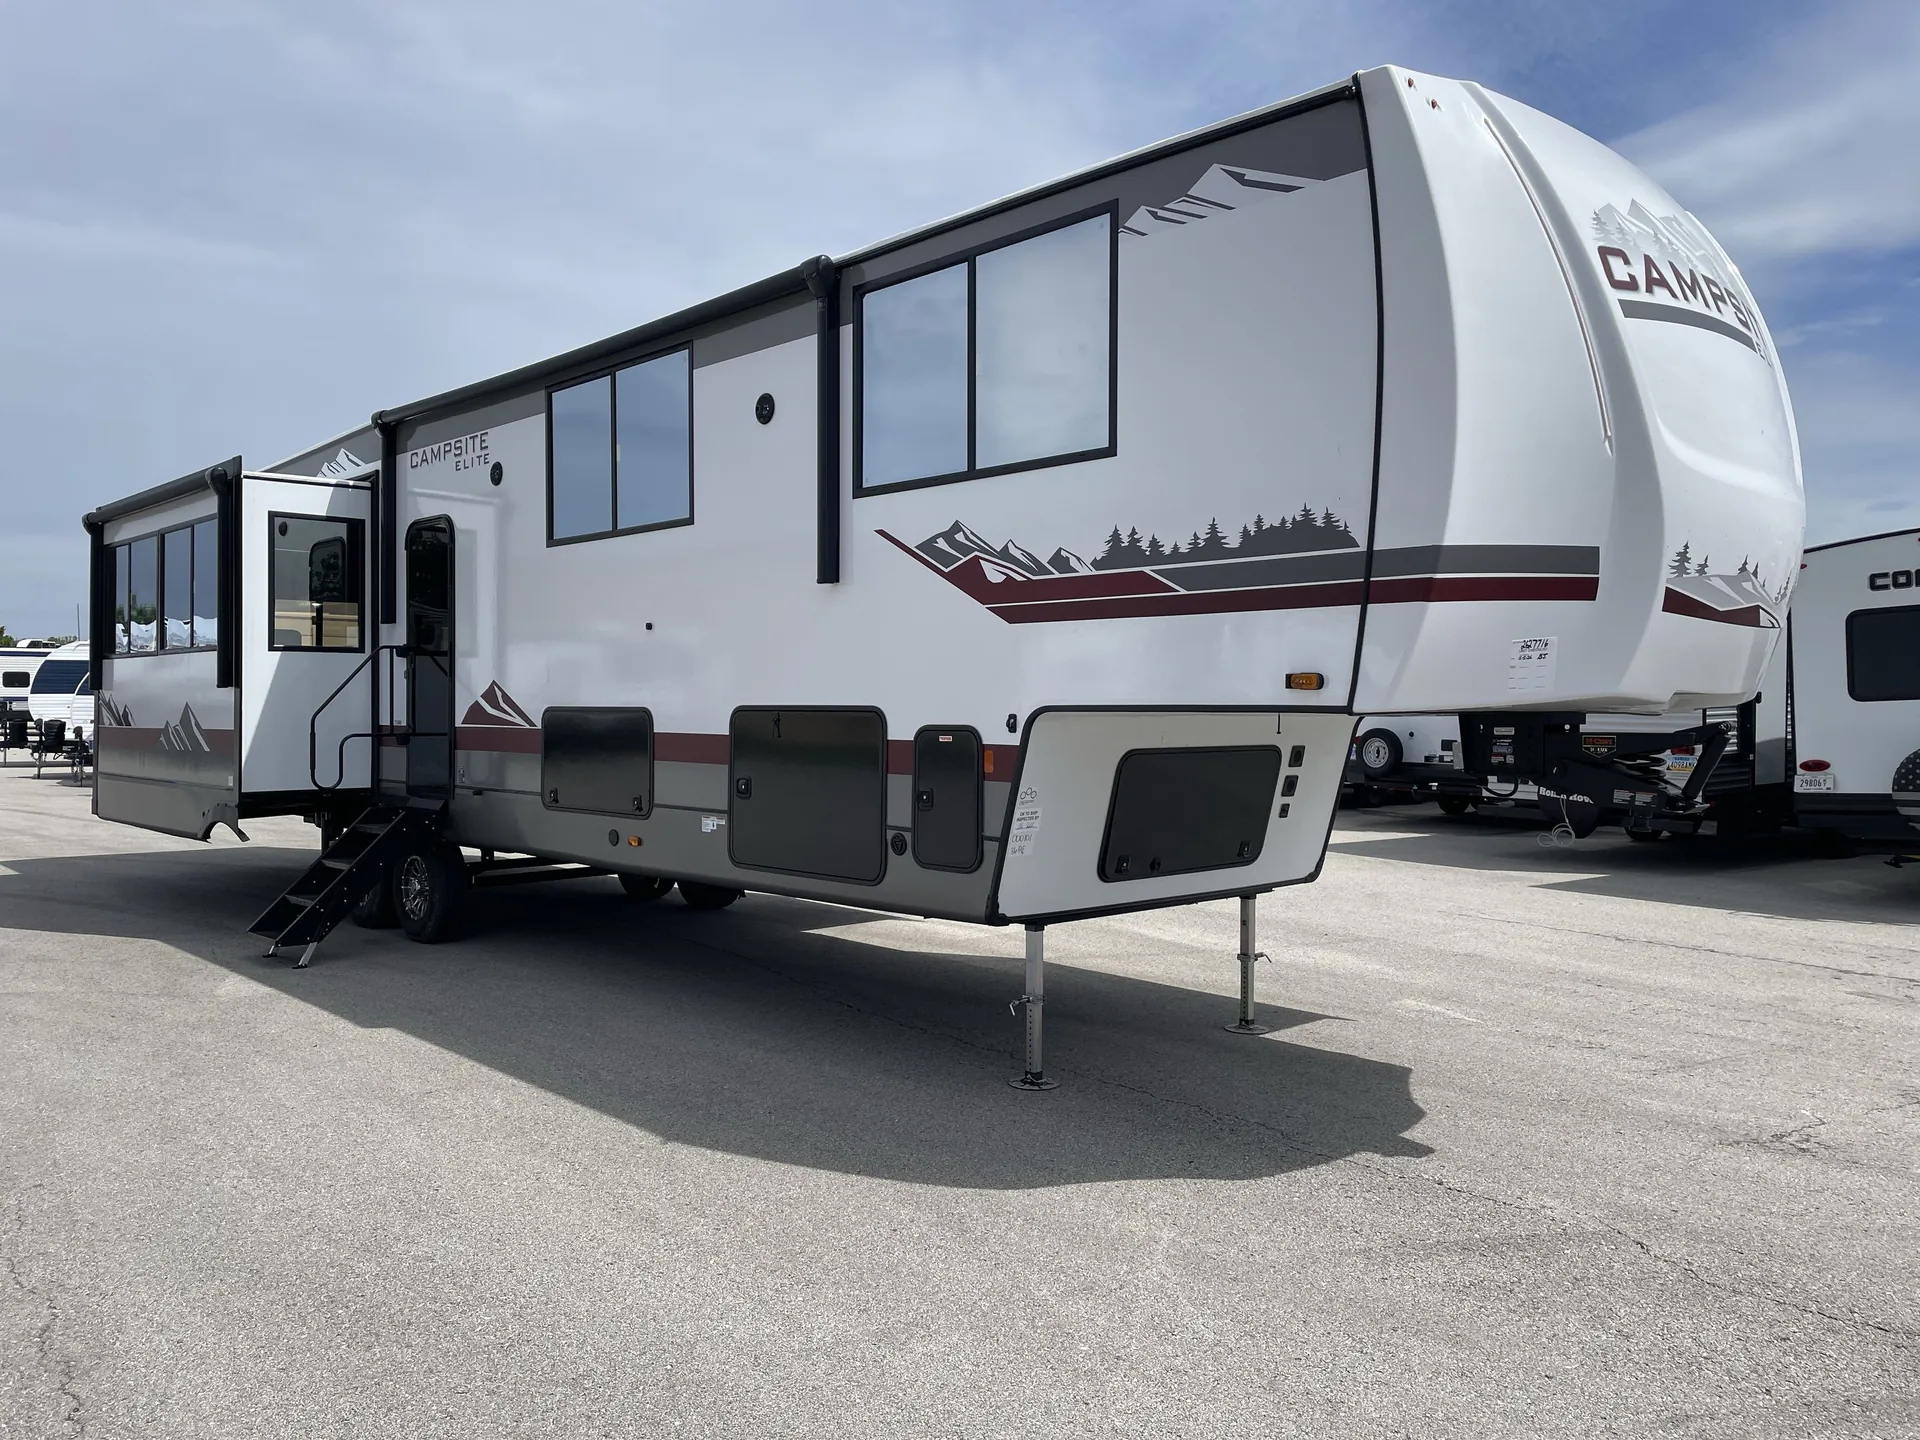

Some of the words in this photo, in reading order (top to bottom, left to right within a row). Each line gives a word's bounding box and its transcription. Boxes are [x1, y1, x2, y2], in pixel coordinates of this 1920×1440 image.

[411, 432, 488, 468] CAMPSITE
[456, 453, 489, 471] ELITE
[1869, 569, 1920, 591] CO
